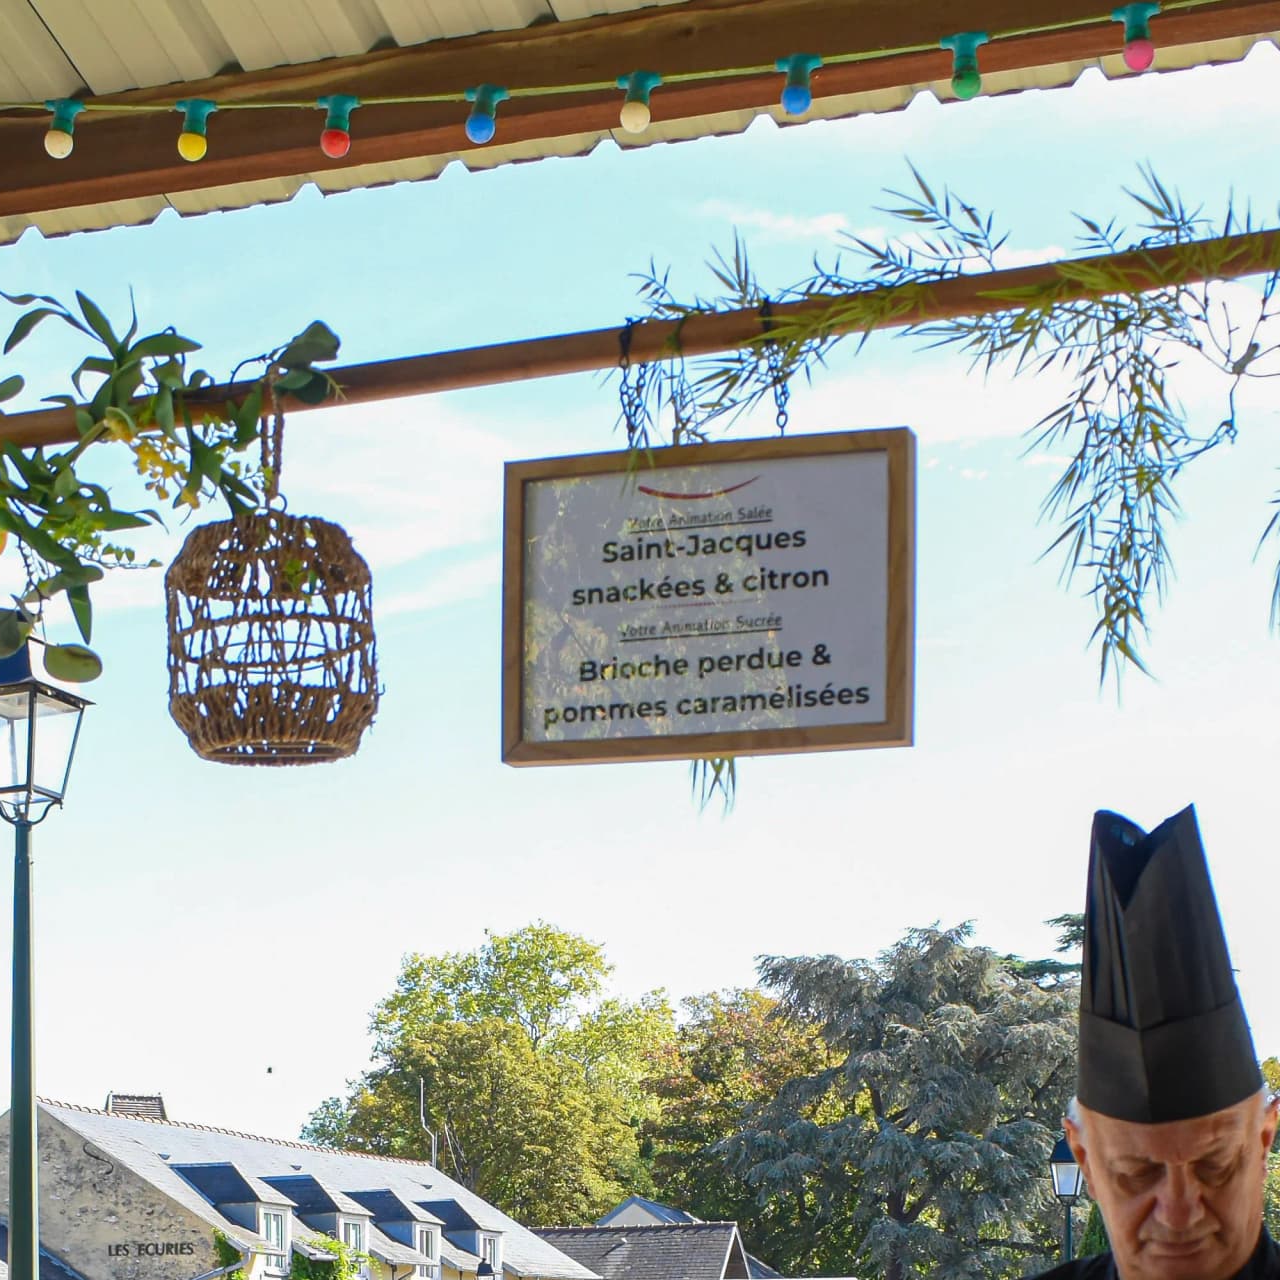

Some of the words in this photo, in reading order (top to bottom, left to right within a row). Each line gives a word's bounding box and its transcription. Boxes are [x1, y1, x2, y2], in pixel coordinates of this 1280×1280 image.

[669, 509, 733, 525] Animation
[738, 504, 774, 520] Salée
[602, 528, 807, 563] Saint-Jacques
[572, 575, 706, 607] snackées
[714, 571, 734, 594] &
[742, 566, 830, 592] citron
[619, 623, 657, 637] Votre
[662, 618, 731, 634] Animation
[736, 612, 783, 629] Sucrée
[579, 651, 689, 683] Brioche
[698, 644, 803, 679] perdue
[812, 642, 832, 666] &
[543, 699, 668, 730] pommes
[676, 682, 871, 717] caramélisées
[108, 1244, 130, 1257] LES
